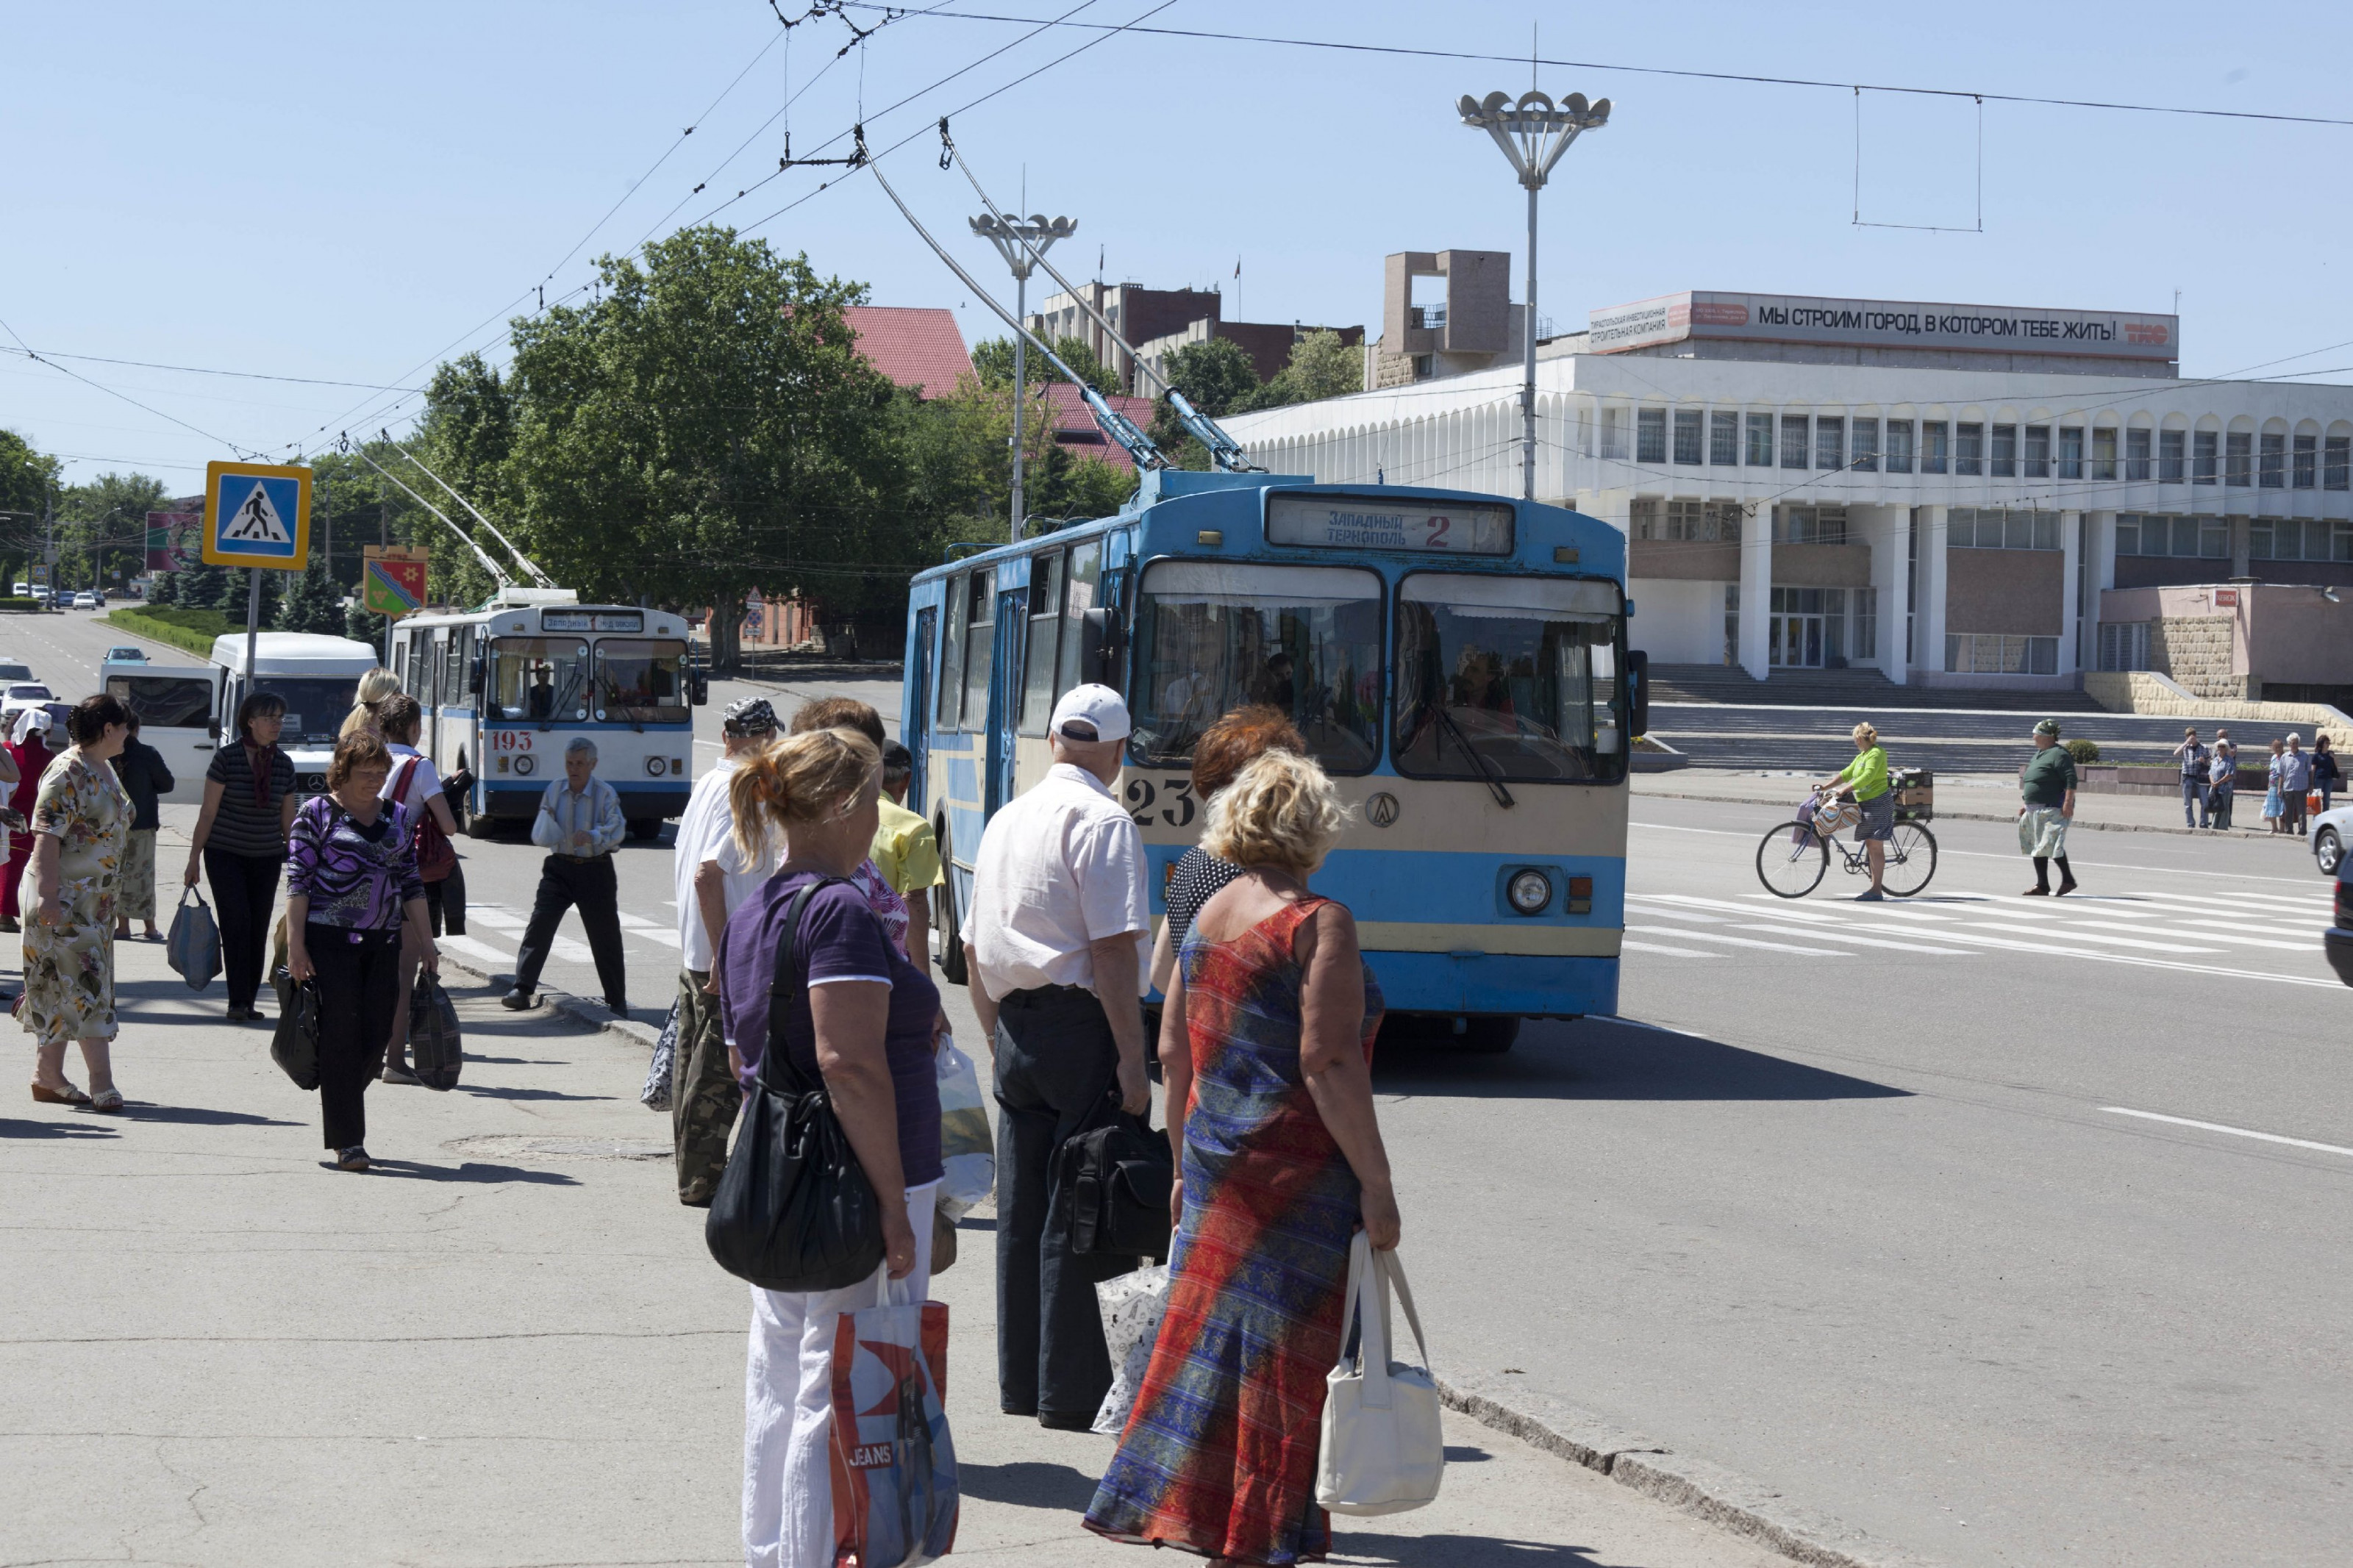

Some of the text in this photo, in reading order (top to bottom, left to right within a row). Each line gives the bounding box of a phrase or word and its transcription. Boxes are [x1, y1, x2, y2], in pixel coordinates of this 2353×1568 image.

[1590, 315, 1626, 329] ТИРАСПОЛЬСКАЯ
[1626, 307, 1665, 323] ИНВЕСТИЦИОННАЯ
[1759, 307, 1788, 324] МЫ
[1792, 309, 1861, 329] СТРОИМ
[1865, 311, 1921, 334] ГОРОД,
[1925, 315, 1935, 332] В
[1940, 316, 2017, 337] КОТОРОМ
[2021, 320, 2059, 338] ТЕБЕ
[2062, 321, 2116, 340] ЖИТЬ!
[1590, 319, 1665, 343] СТРОИТЕЛЬНАЯ КОМПАНИЯ
[1329, 510, 1402, 529] ЗАПАДНЫЙ
[1327, 528, 1406, 545] ТЕРНОПОЛЬ
[1426, 516, 1451, 547] 2
[590, 616, 597, 631] 1
[492, 730, 532, 751] 193
[849, 1445, 891, 1467] JEANS
